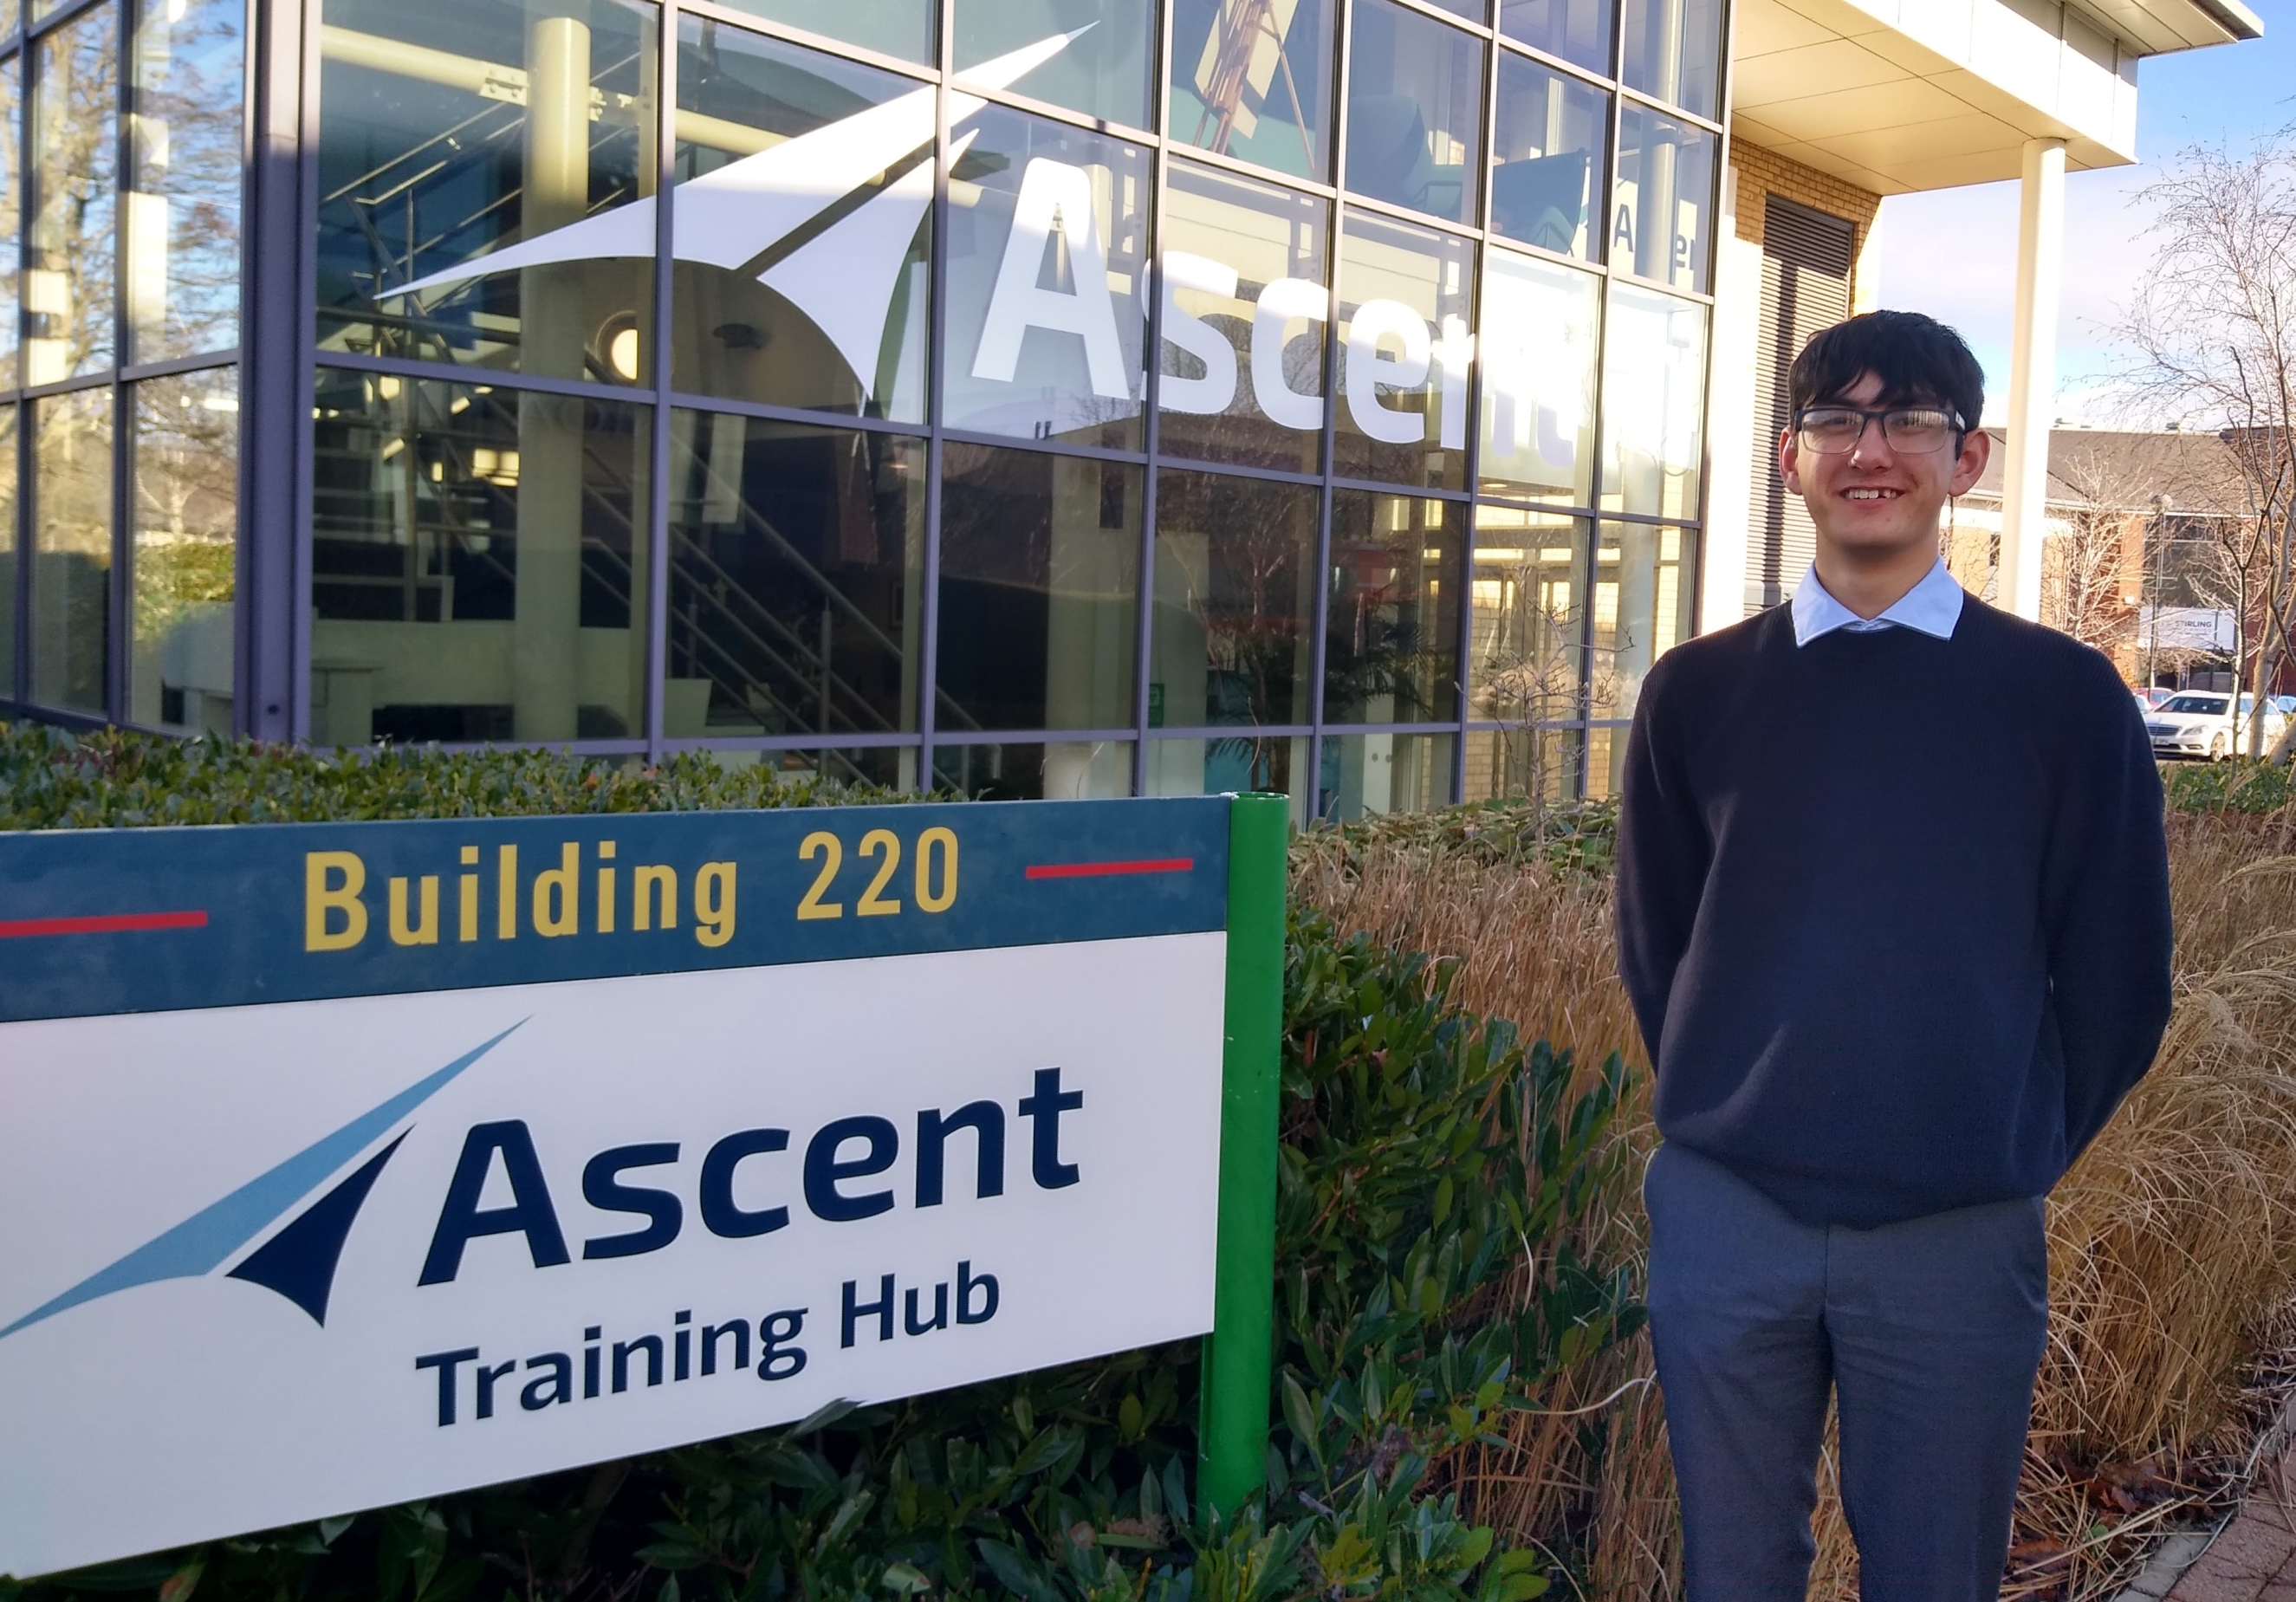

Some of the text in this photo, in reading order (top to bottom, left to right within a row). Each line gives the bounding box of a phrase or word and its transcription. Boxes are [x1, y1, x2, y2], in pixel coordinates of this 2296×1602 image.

[306, 827, 958, 951] Building 220
[416, 1067, 1084, 1287] Ascent
[415, 1260, 1000, 1428] Training Hub
